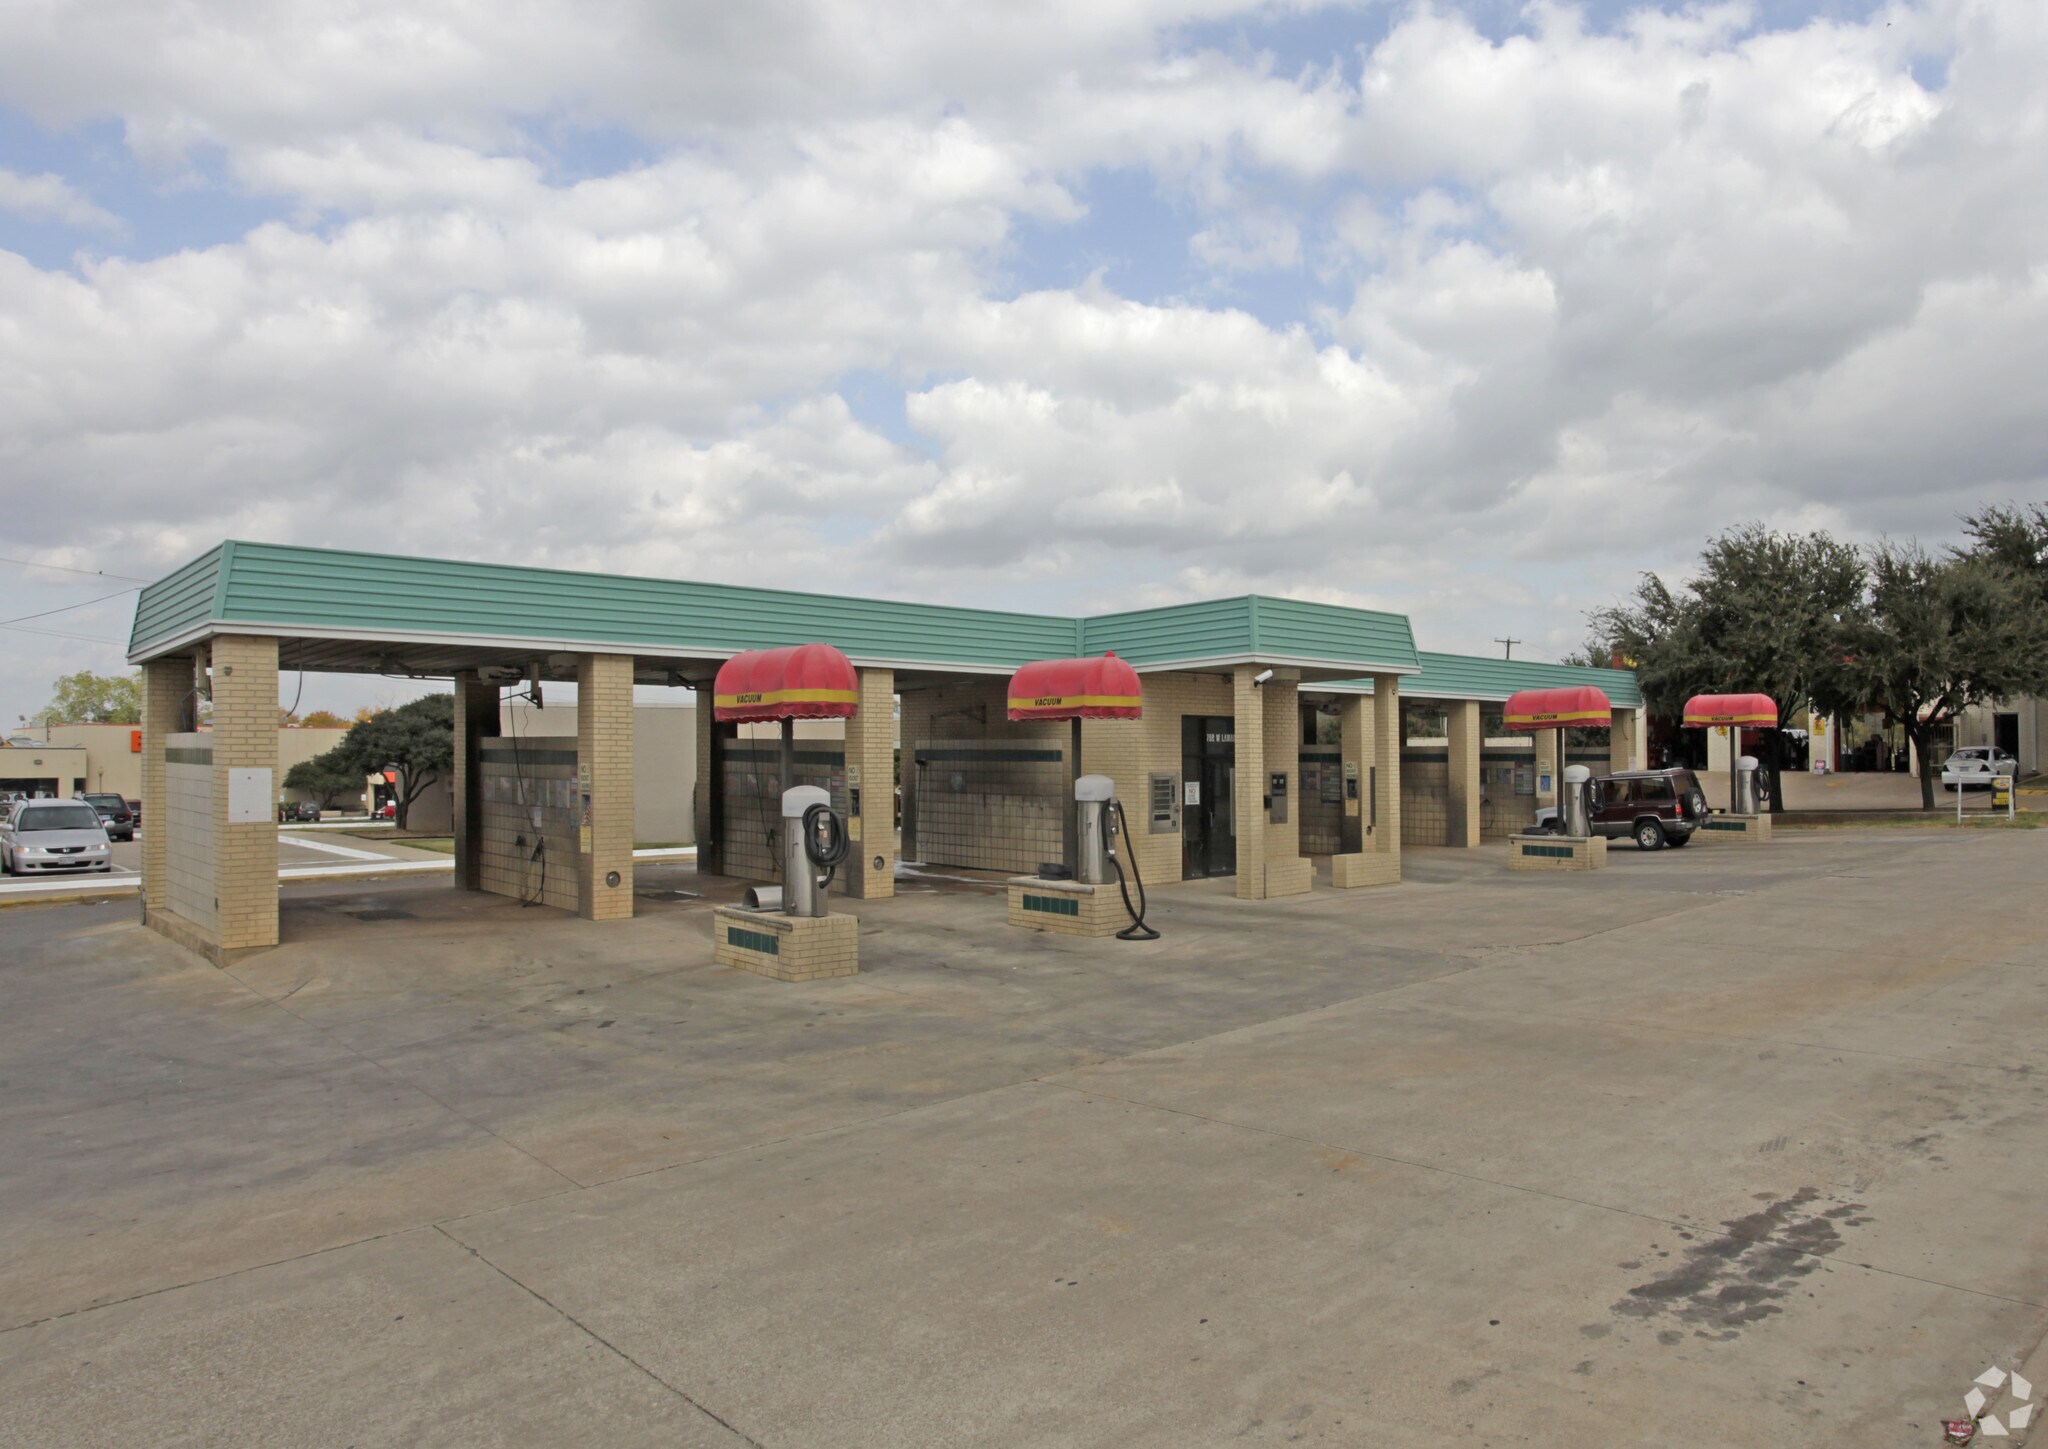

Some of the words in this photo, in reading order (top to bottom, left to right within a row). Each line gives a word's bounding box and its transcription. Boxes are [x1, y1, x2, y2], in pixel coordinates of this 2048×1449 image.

[736, 694, 762, 704] VACUUM
[1034, 698, 1062, 706] VACUUM
[1222, 734, 1235, 742] LAMA
